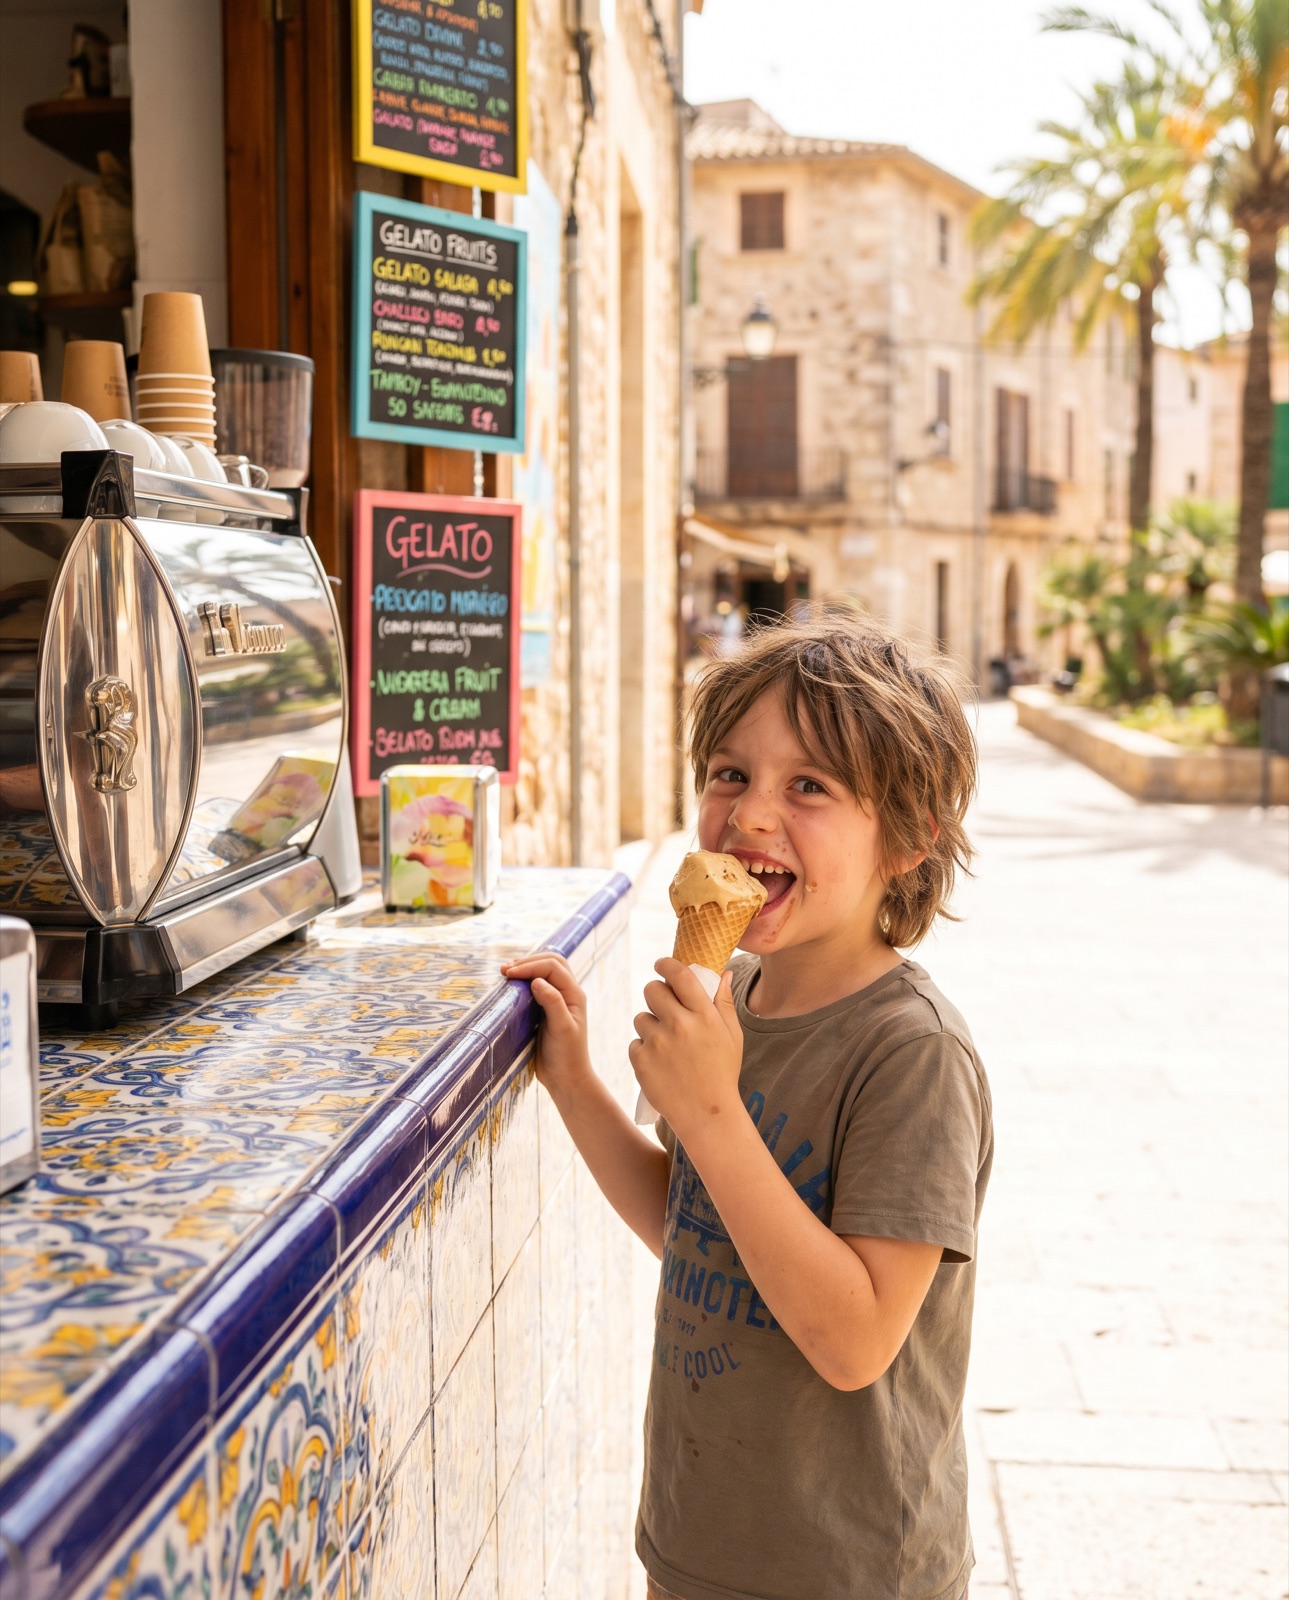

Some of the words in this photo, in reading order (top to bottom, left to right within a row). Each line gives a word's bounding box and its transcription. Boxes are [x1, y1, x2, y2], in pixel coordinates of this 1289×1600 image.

[373, 9, 421, 37] GELATO
[379, 220, 443, 254] GELATO
[446, 234, 498, 265] FRUITS
[373, 256, 431, 286] GELATO
[386, 516, 493, 569] GELATO
[455, 665, 503, 693] FRUIT
[684, 1342, 742, 1379] COOL
